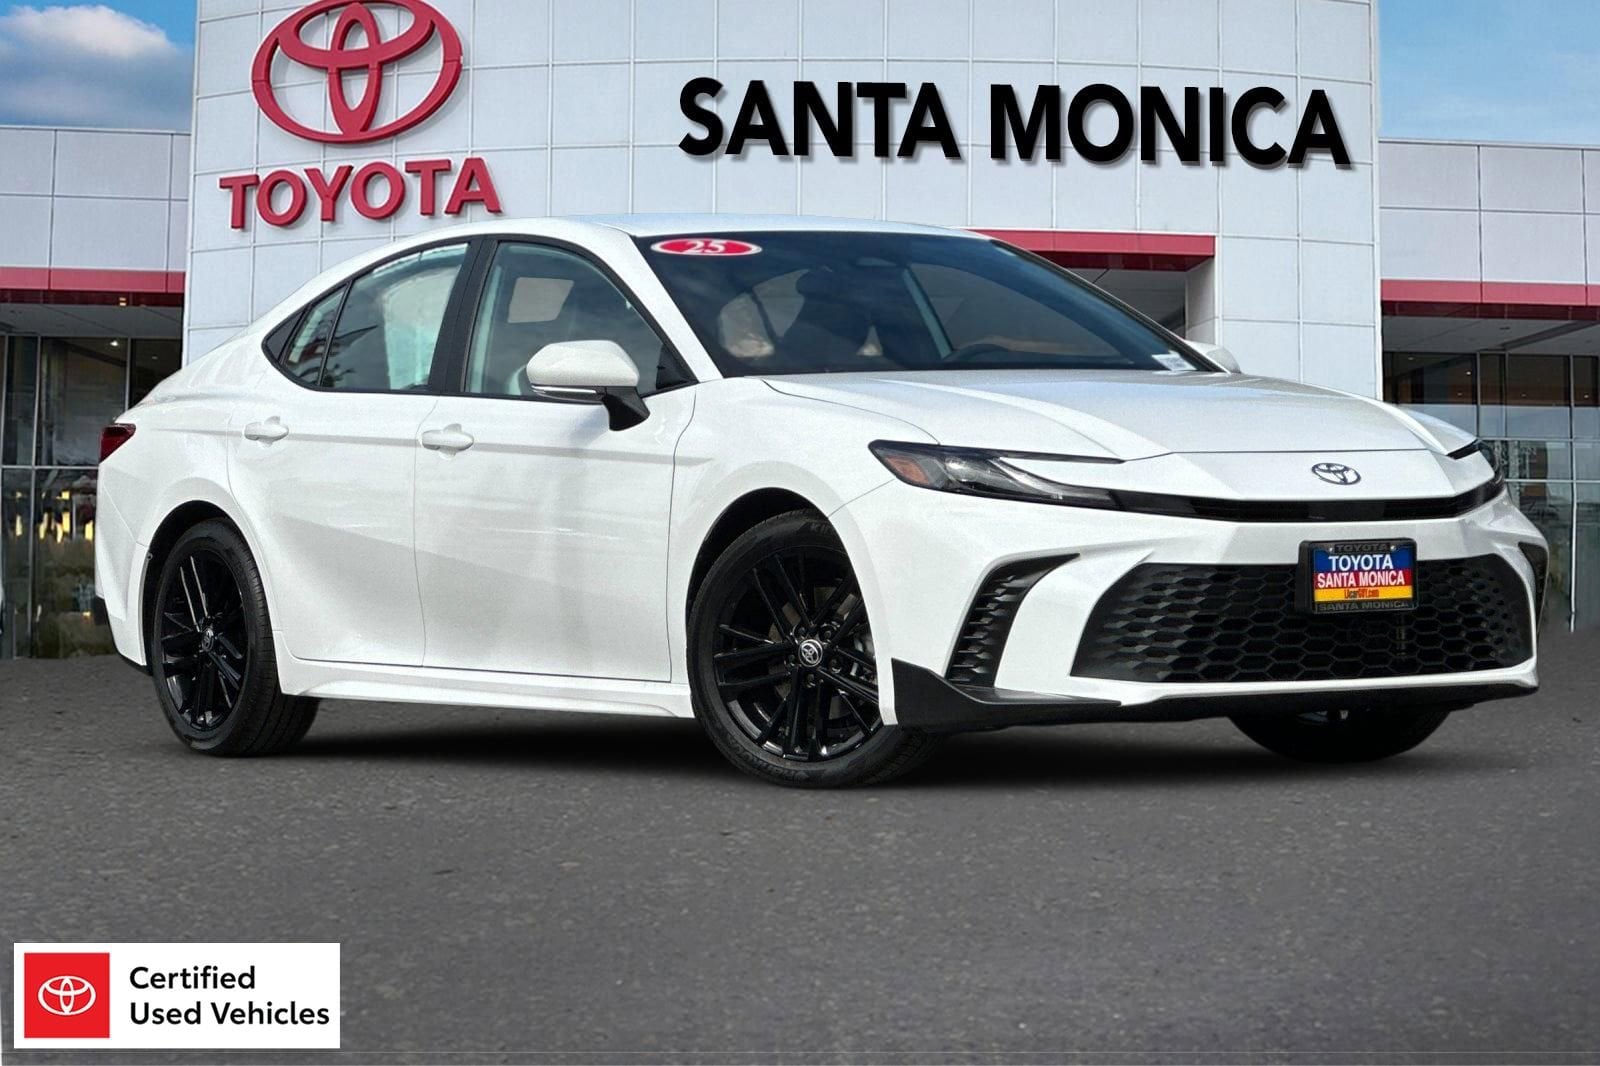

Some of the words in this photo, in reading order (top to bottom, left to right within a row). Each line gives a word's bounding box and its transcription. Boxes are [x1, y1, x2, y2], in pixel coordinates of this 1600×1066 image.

[679, 78, 961, 159] SANTA
[991, 84, 1350, 168] MONICA
[220, 157, 500, 228] TOYOTA
[682, 239, 726, 253] 25
[1335, 543, 1389, 552] TOYOTA
[1328, 554, 1394, 571] TOYOTA
[1317, 572, 1357, 588] SANTA
[1359, 570, 1405, 587] MONICA
[1320, 603, 1359, 611] SANTA
[1361, 600, 1410, 609] MONICA
